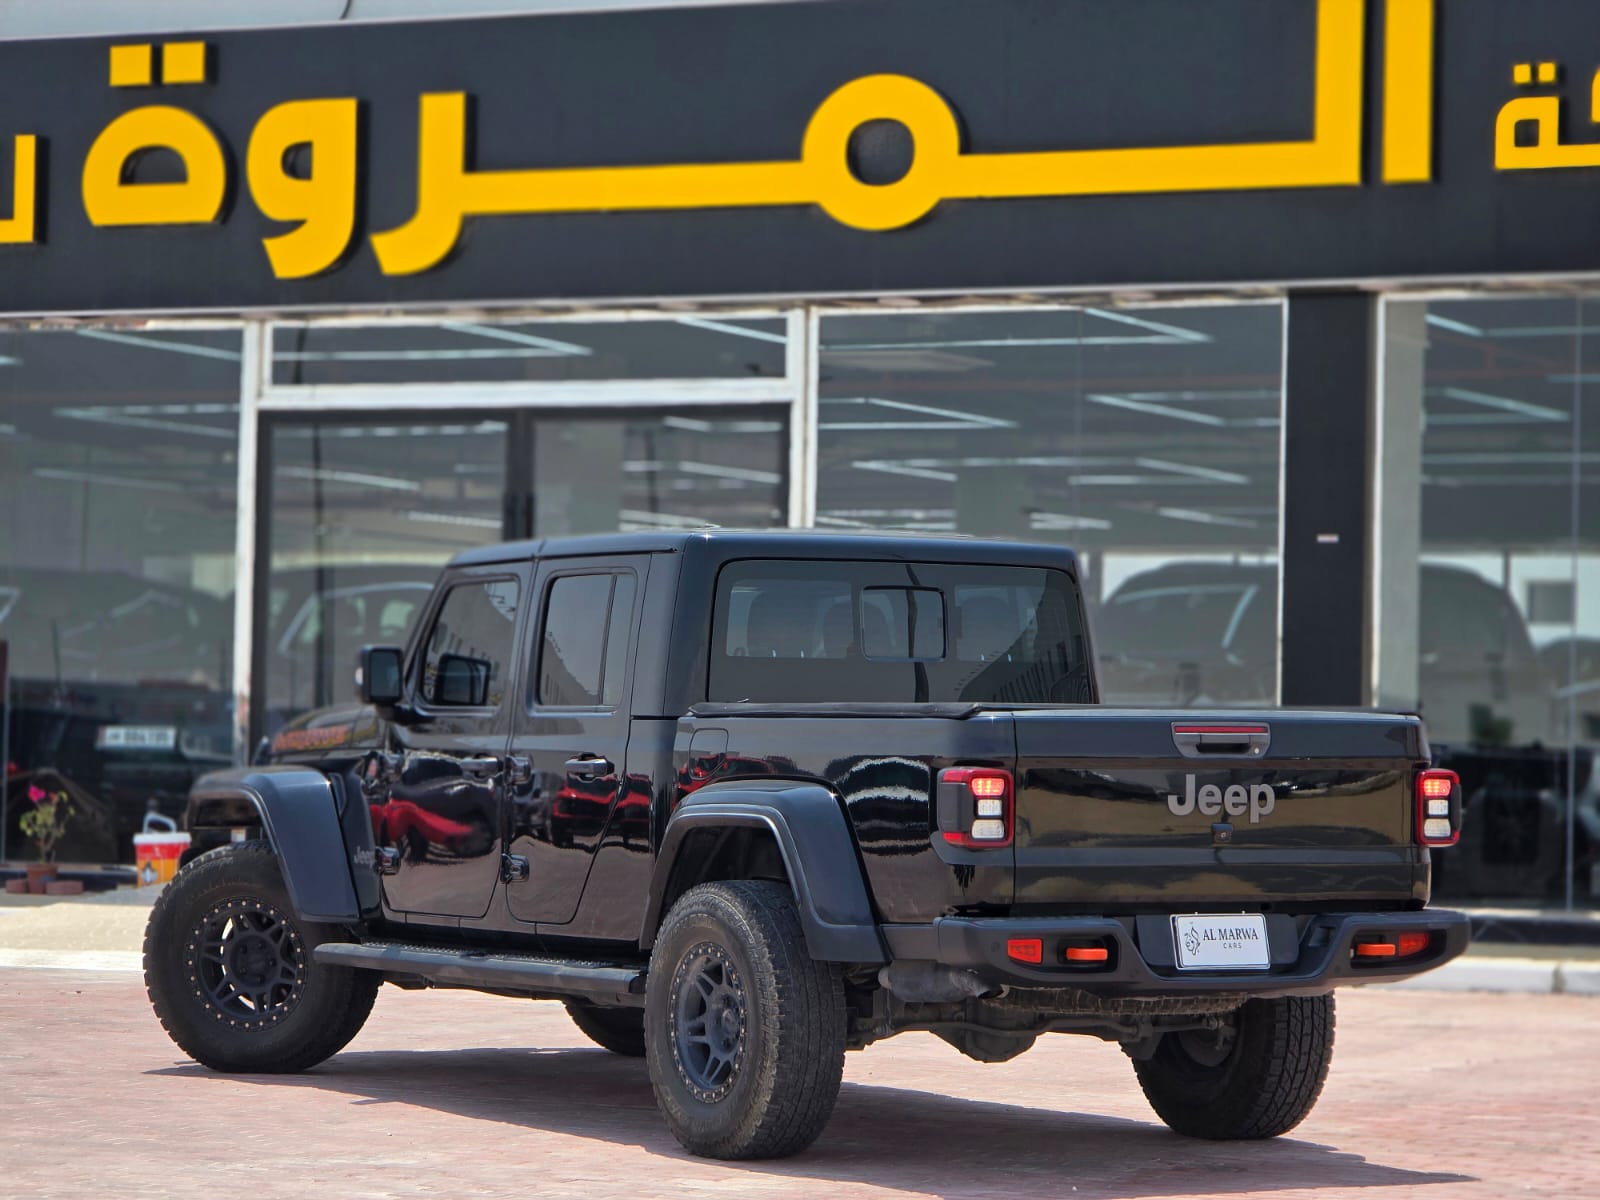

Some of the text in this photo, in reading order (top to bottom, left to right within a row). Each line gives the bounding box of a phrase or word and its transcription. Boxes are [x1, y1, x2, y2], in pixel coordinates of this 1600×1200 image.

[1167, 773, 1276, 824] Jeep
[1203, 927, 1259, 941] AL MARWA
